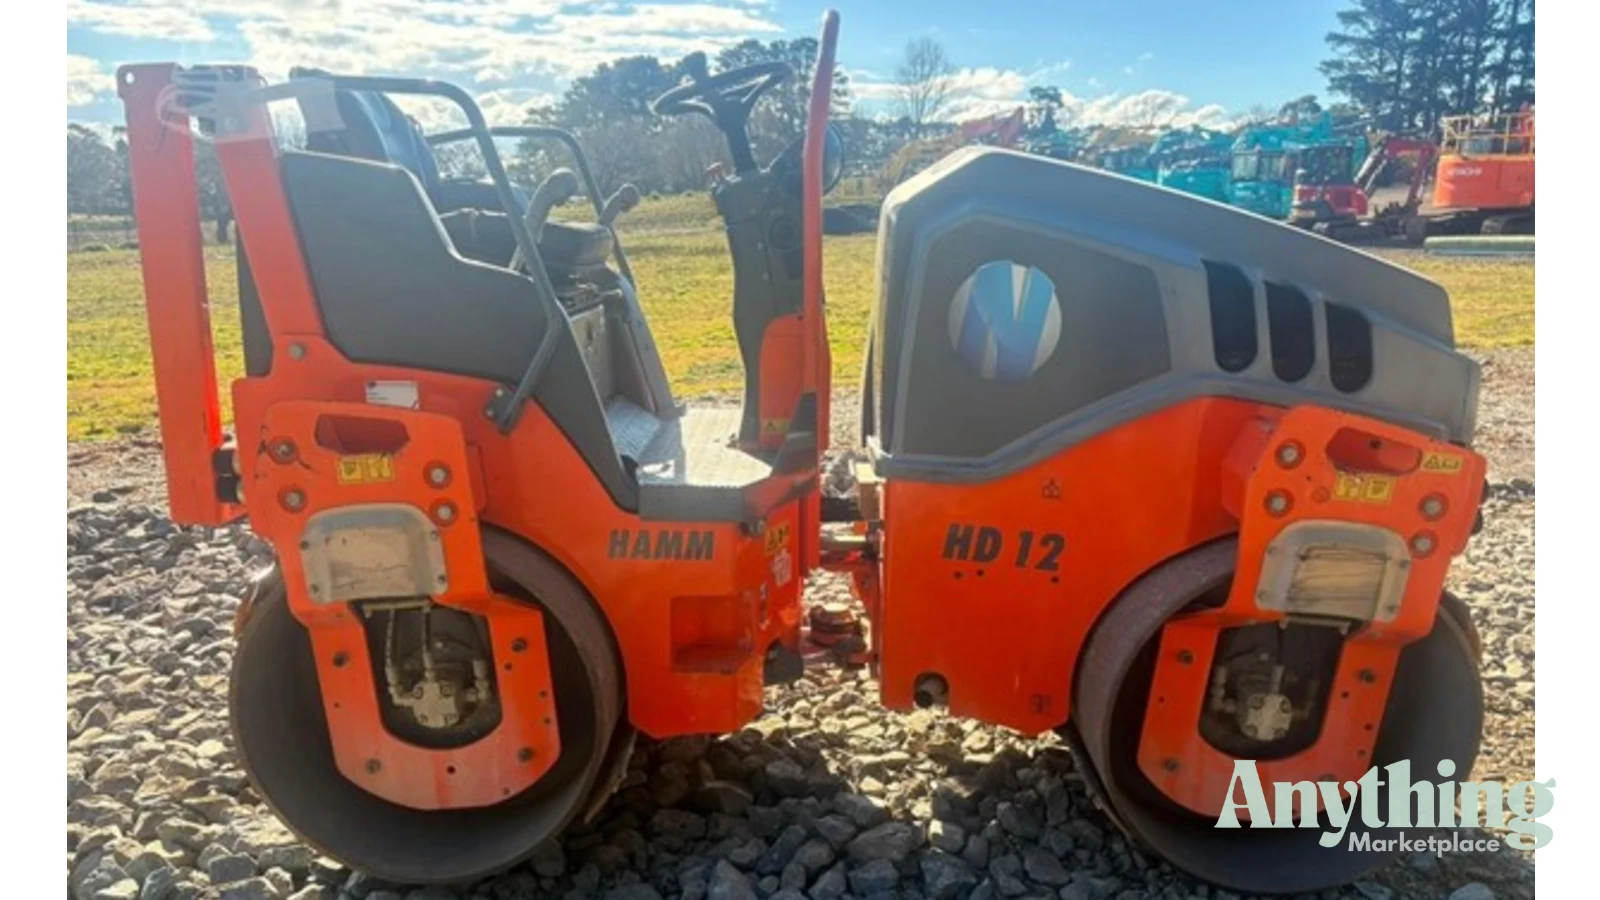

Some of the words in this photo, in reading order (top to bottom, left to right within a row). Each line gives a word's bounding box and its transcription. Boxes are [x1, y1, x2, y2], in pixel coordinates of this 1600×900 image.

[607, 529, 715, 561] HAMM
[942, 523, 1004, 563] HD
[1014, 530, 1066, 572] 12
